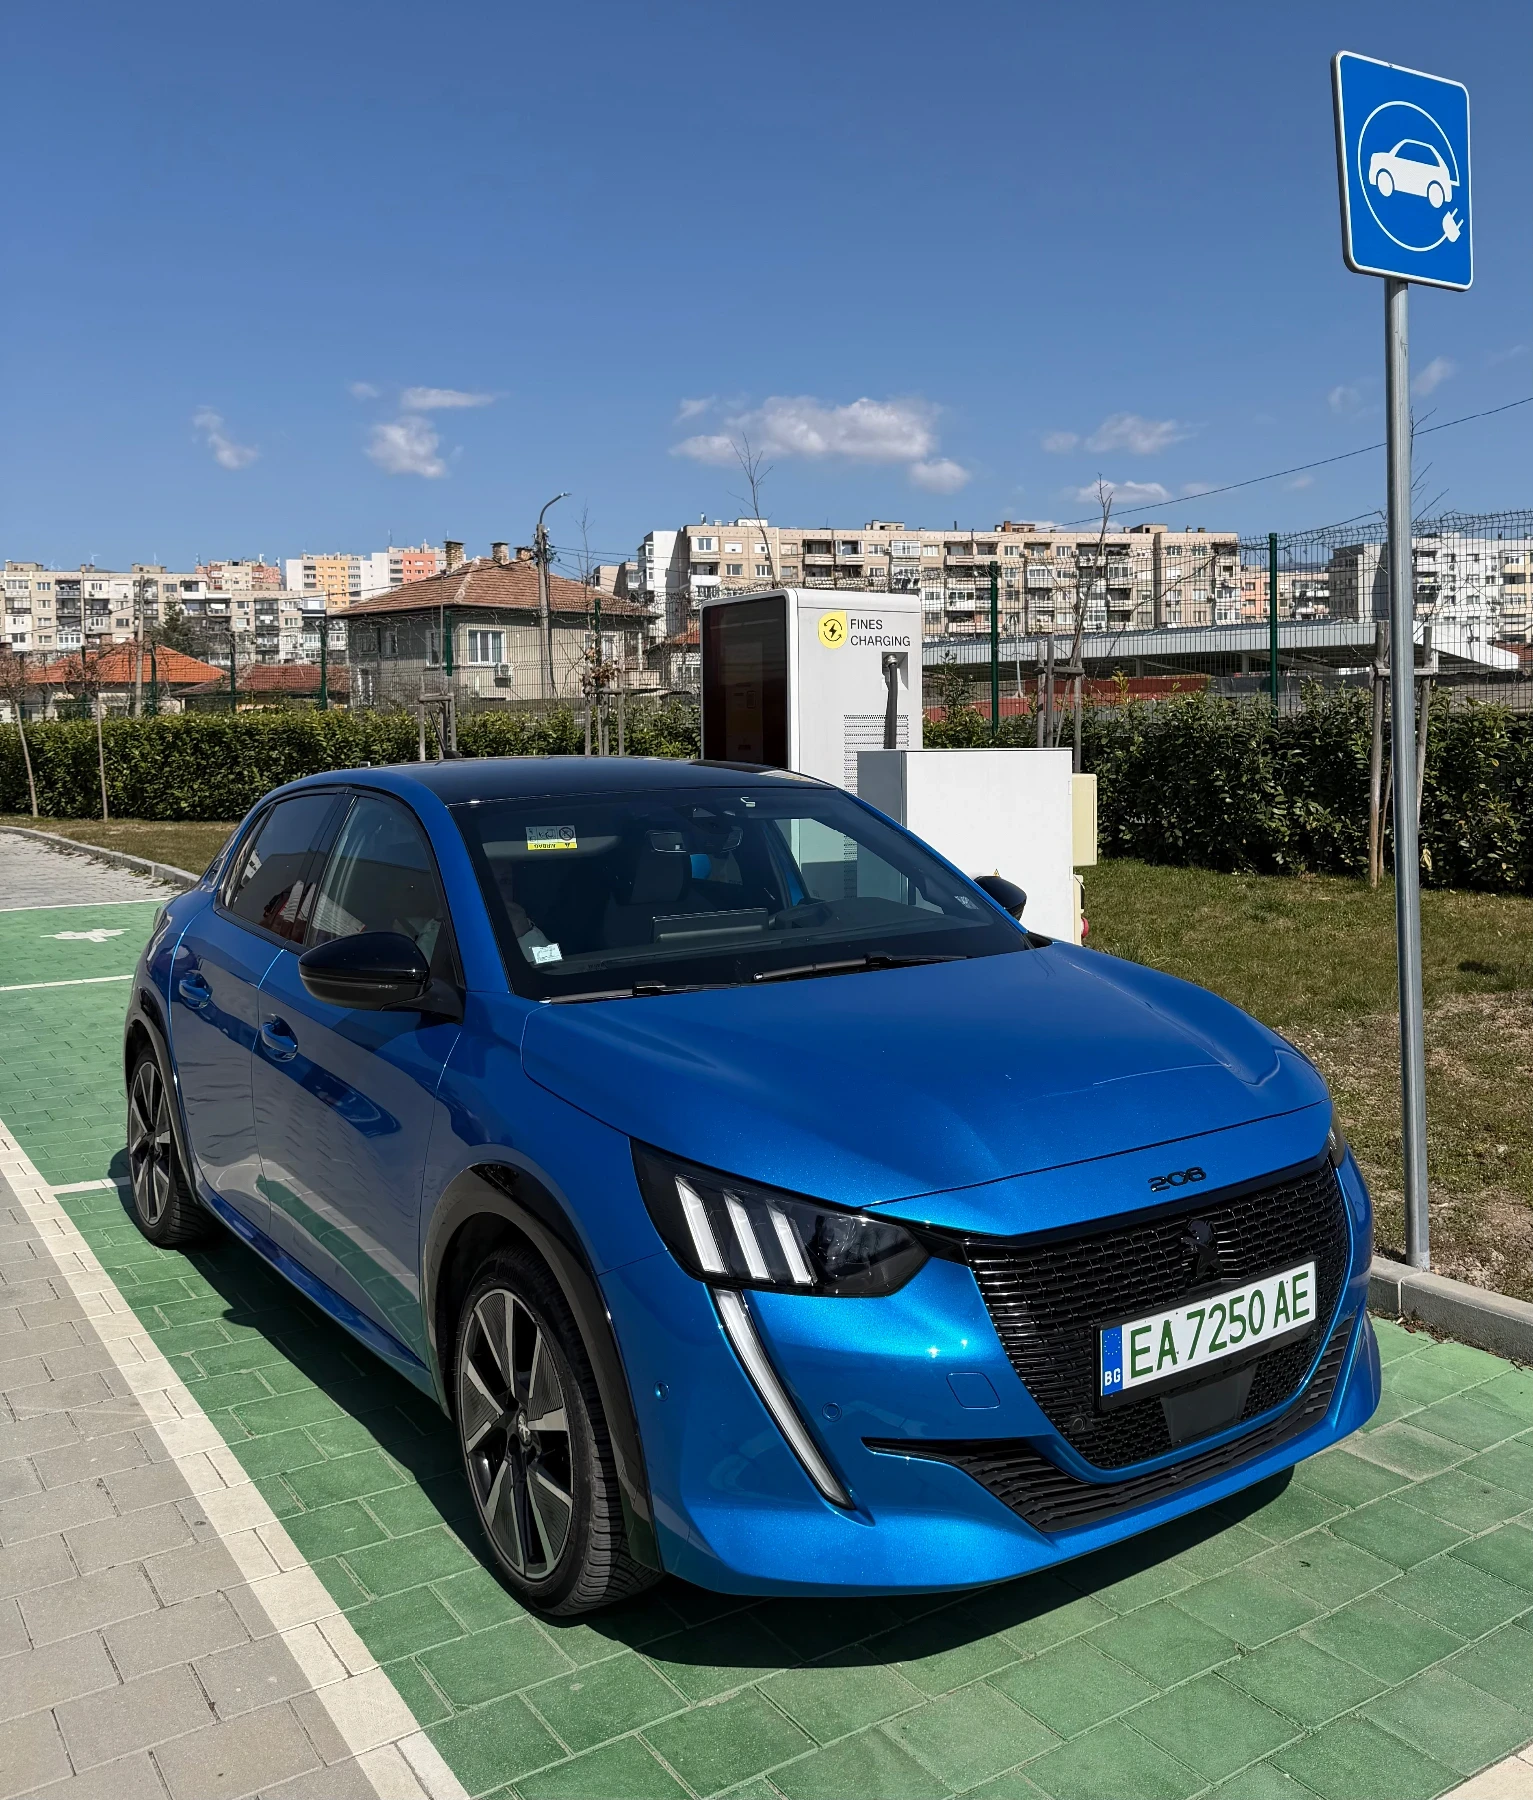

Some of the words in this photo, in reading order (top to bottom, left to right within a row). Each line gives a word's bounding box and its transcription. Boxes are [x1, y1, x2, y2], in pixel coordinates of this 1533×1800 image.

[850, 618, 883, 630] FINES
[850, 635, 911, 647] CHARGING
[1147, 1166, 1207, 1192] 208
[1130, 1319, 1178, 1379] EA
[1186, 1289, 1266, 1361] 7250
[1272, 1270, 1310, 1330] AE
[1104, 1367, 1121, 1387] BG
